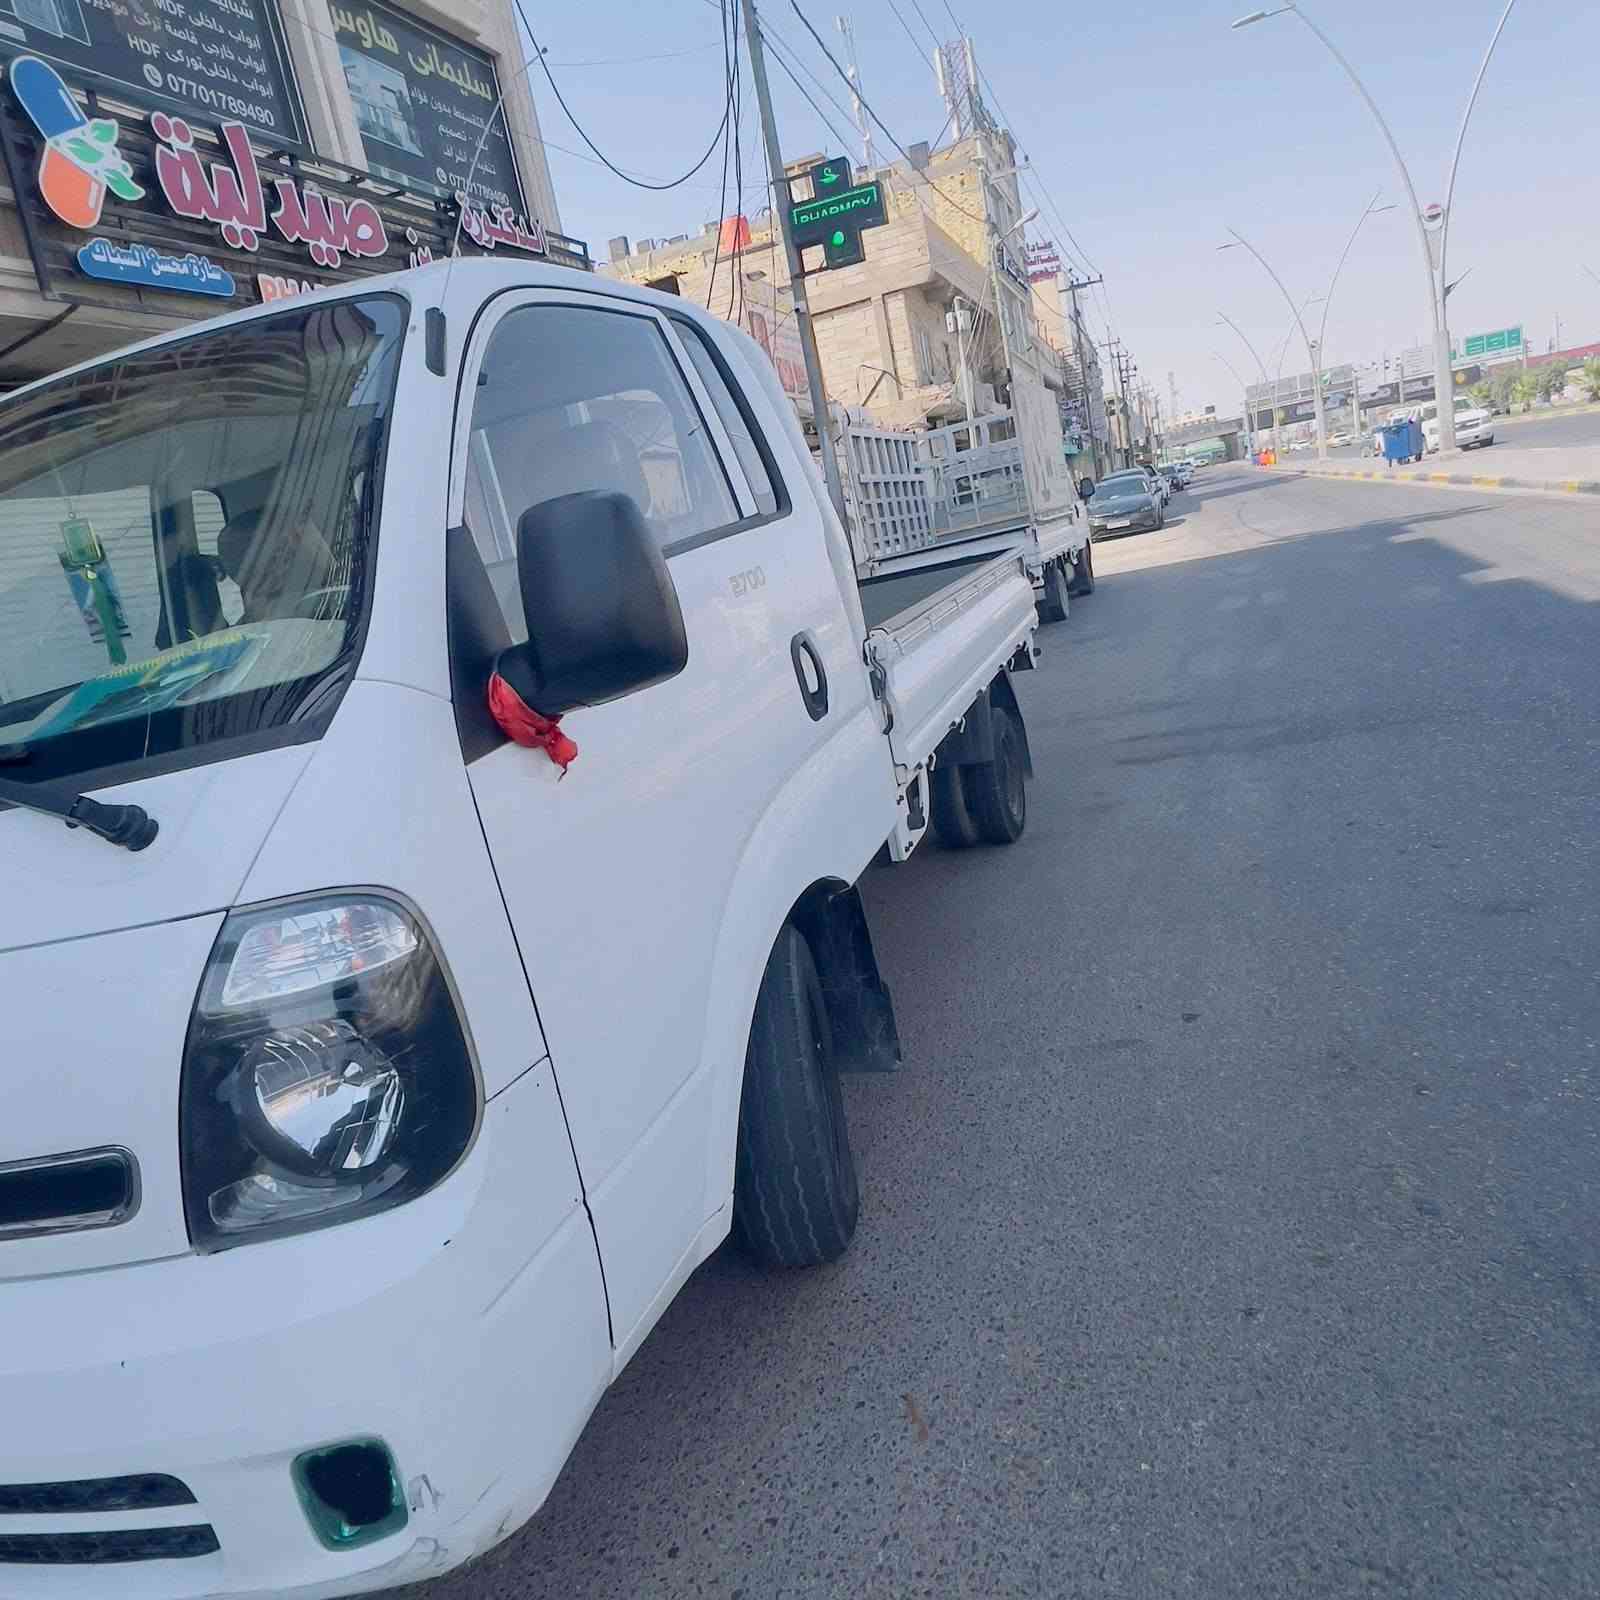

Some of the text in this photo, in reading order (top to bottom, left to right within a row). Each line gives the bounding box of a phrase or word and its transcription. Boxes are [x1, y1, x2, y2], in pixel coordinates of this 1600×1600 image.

[153, 0, 185, 18] MDF
[127, 32, 161, 58] HDF
[167, 73, 275, 127] 07701789490
[150, 110, 389, 269] صيدلية
